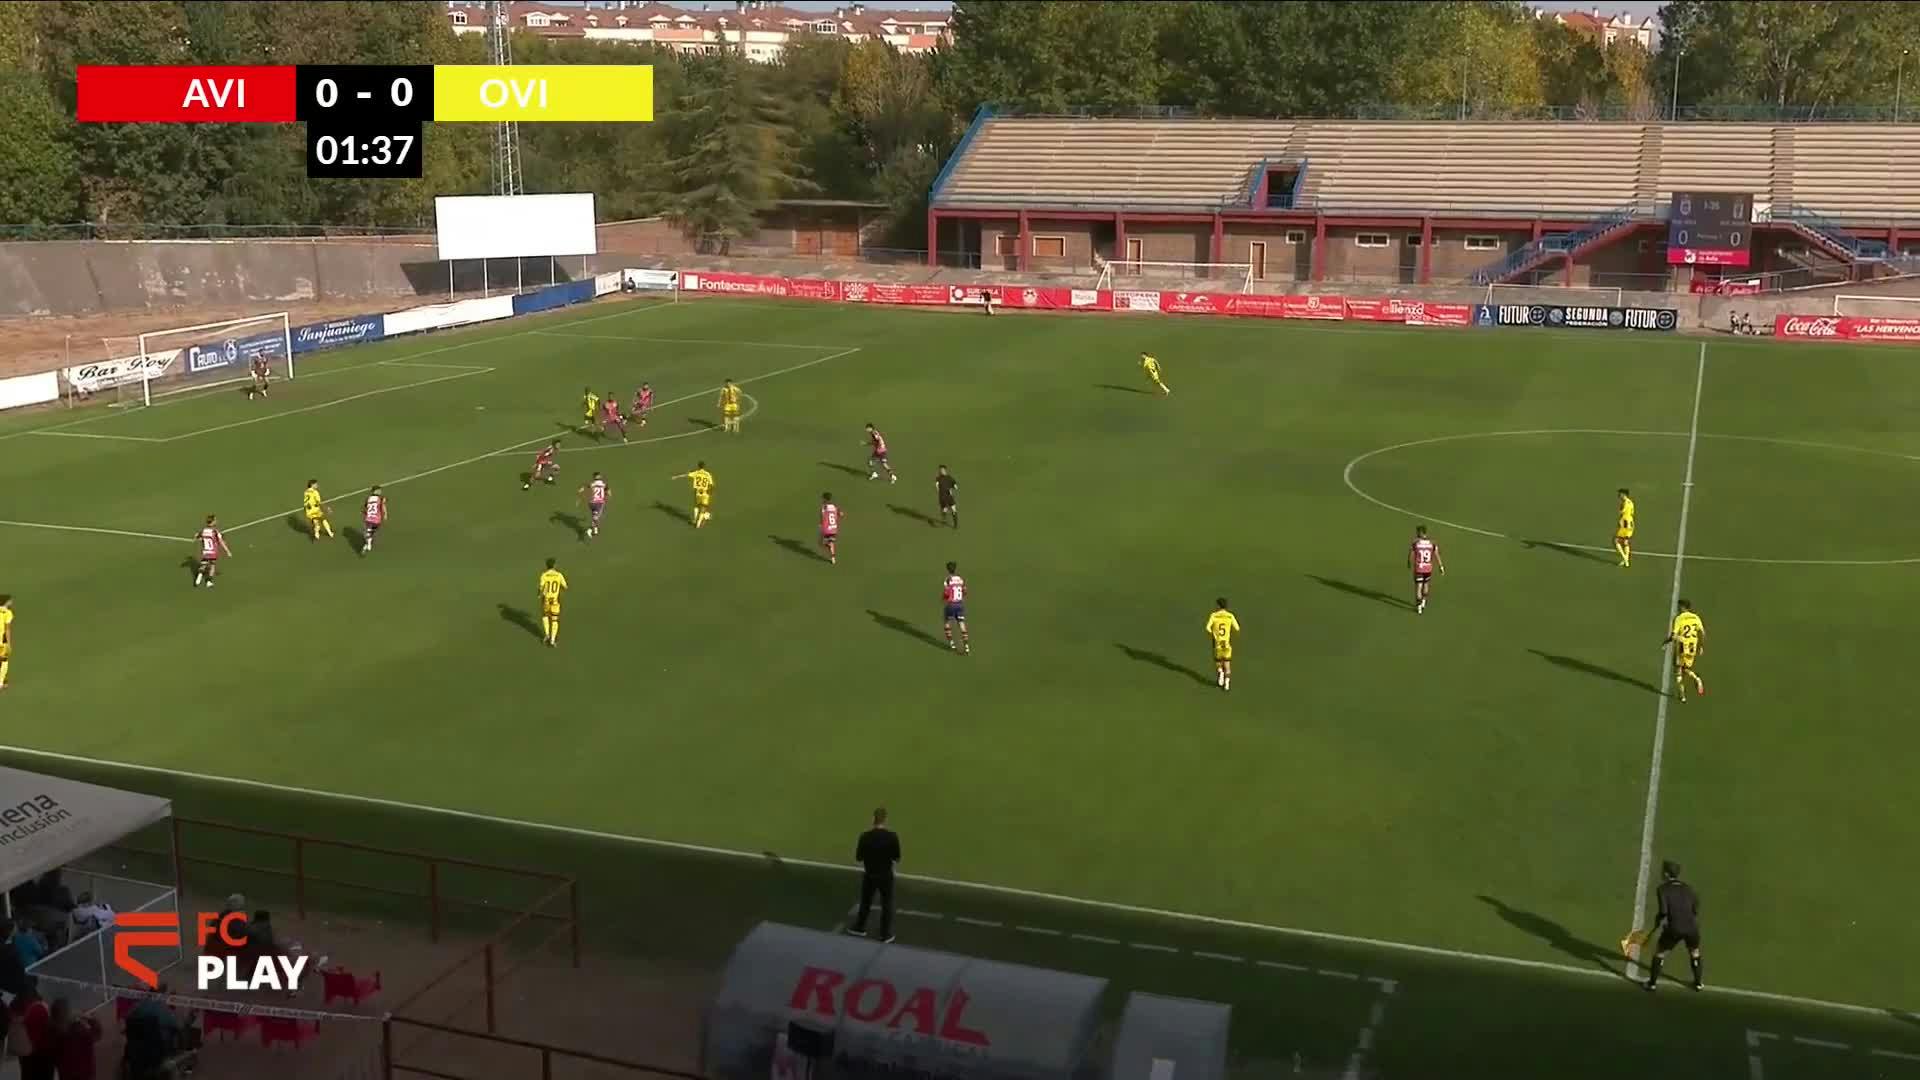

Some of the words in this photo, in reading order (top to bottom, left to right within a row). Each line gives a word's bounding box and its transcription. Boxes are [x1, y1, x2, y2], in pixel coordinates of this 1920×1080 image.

[1678, 230, 1689, 245] 0
[1730, 231, 1741, 247] 0
[1565, 307, 1608, 321] SEGUNDA
[297, 321, 376, 345] Sanjuaniego
[78, 365, 118, 381] Bar
[594, 487, 605, 498] 21
[1419, 549, 1432, 562] 19
[545, 580, 558, 593] 10
[1218, 623, 1226, 636] 5
[1683, 625, 1698, 639] 23
[790, 966, 993, 1048] ROAL
